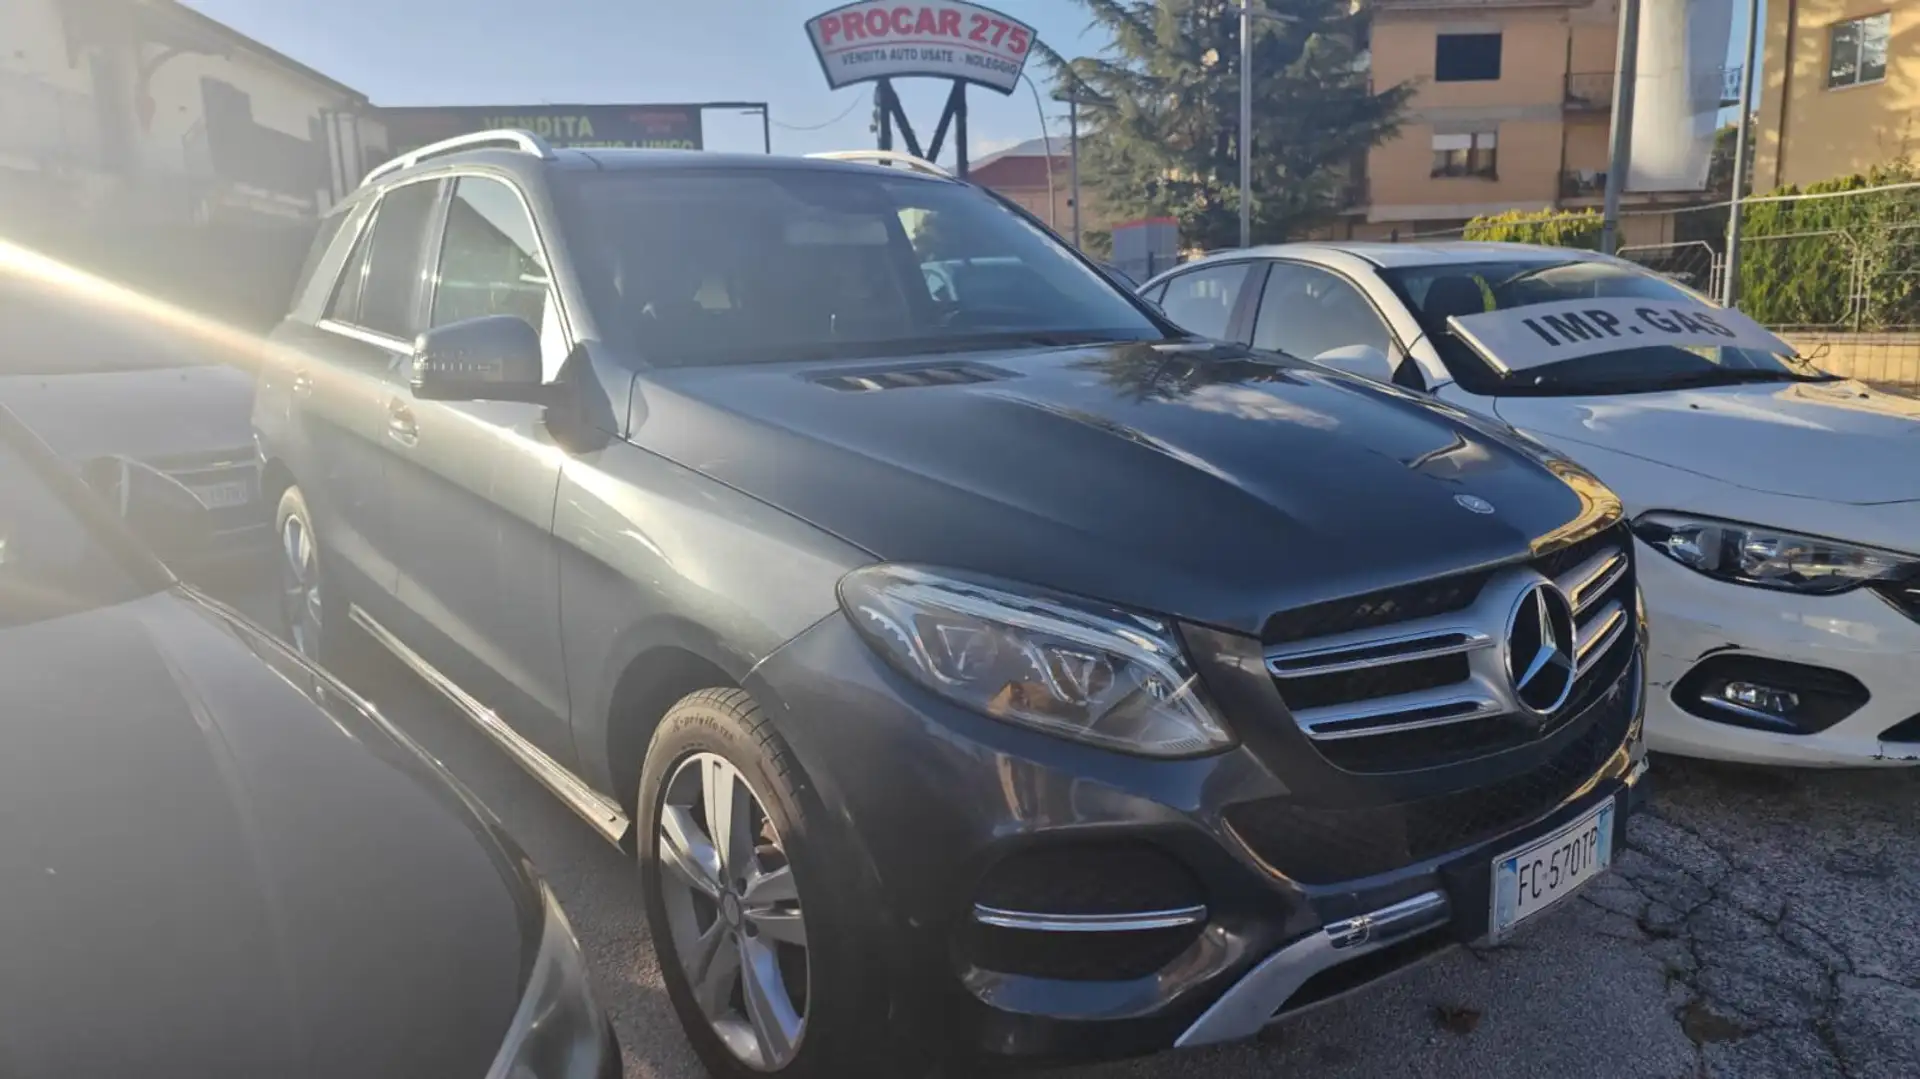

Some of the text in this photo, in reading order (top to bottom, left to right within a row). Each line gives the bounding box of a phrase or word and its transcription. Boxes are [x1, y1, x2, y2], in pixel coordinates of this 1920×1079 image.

[819, 7, 1029, 54] PROCAR 275
[841, 48, 887, 66] VENDITA
[890, 47, 918, 61] AUTO
[920, 47, 954, 63] USATE
[965, 52, 1018, 75] NOLEGGIO
[483, 115, 594, 138] VENDITA
[1634, 307, 1737, 339] GAS
